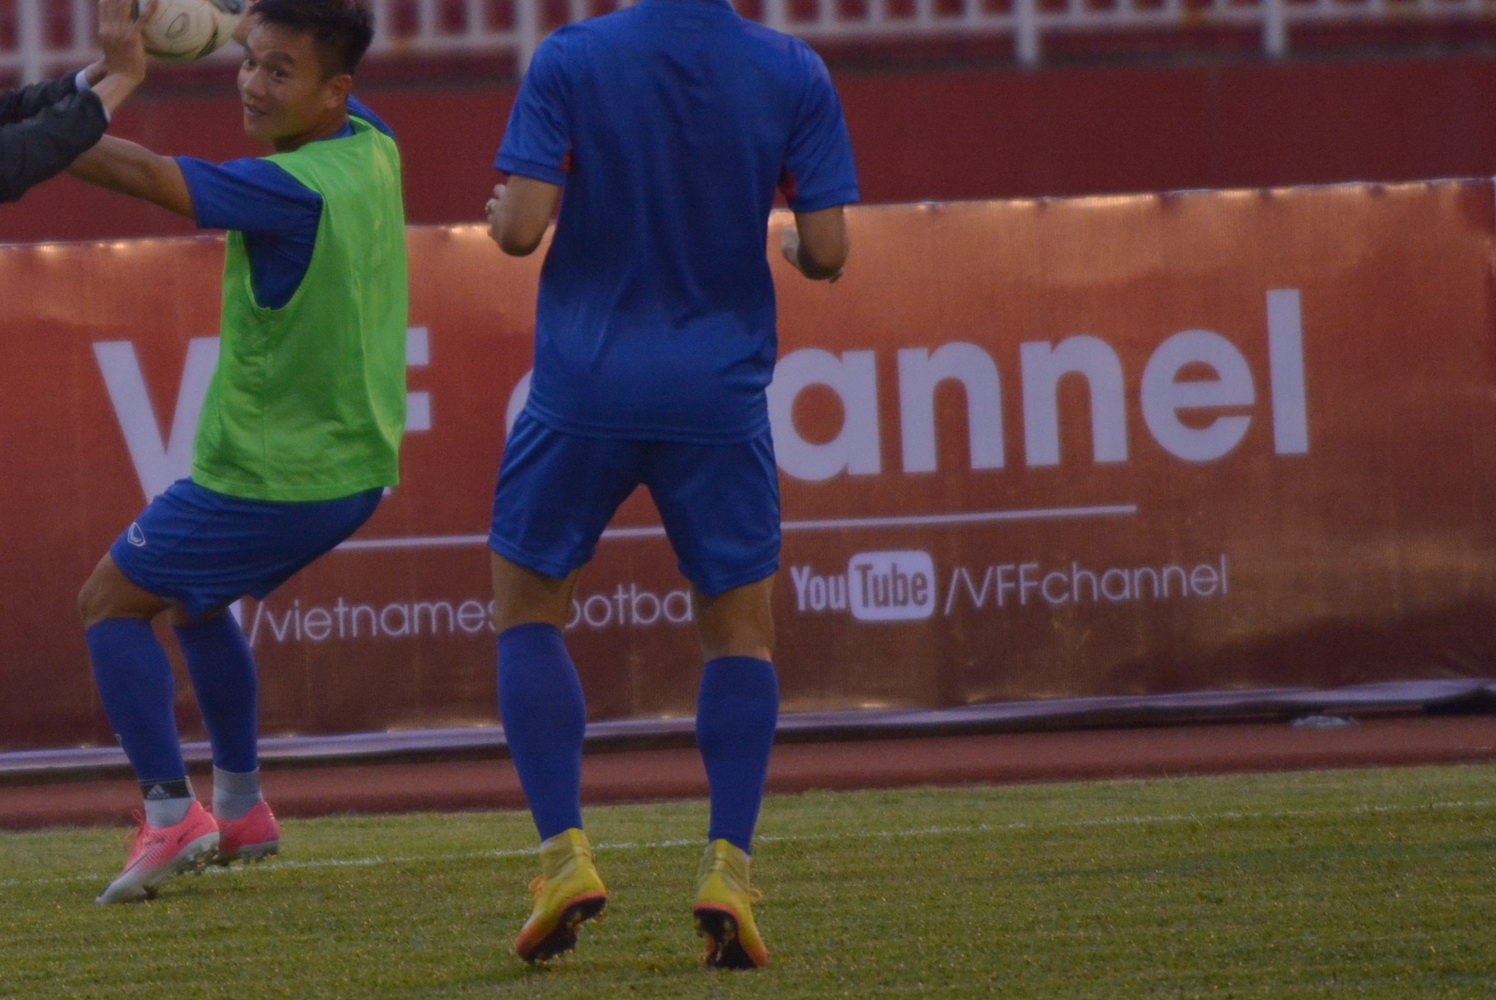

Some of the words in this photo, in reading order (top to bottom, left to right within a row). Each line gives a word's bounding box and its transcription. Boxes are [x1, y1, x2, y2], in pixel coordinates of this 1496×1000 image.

[506, 288, 1309, 482] annel
[789, 556, 933, 616] YouTube
[943, 553, 1230, 616] /VFFchannel
